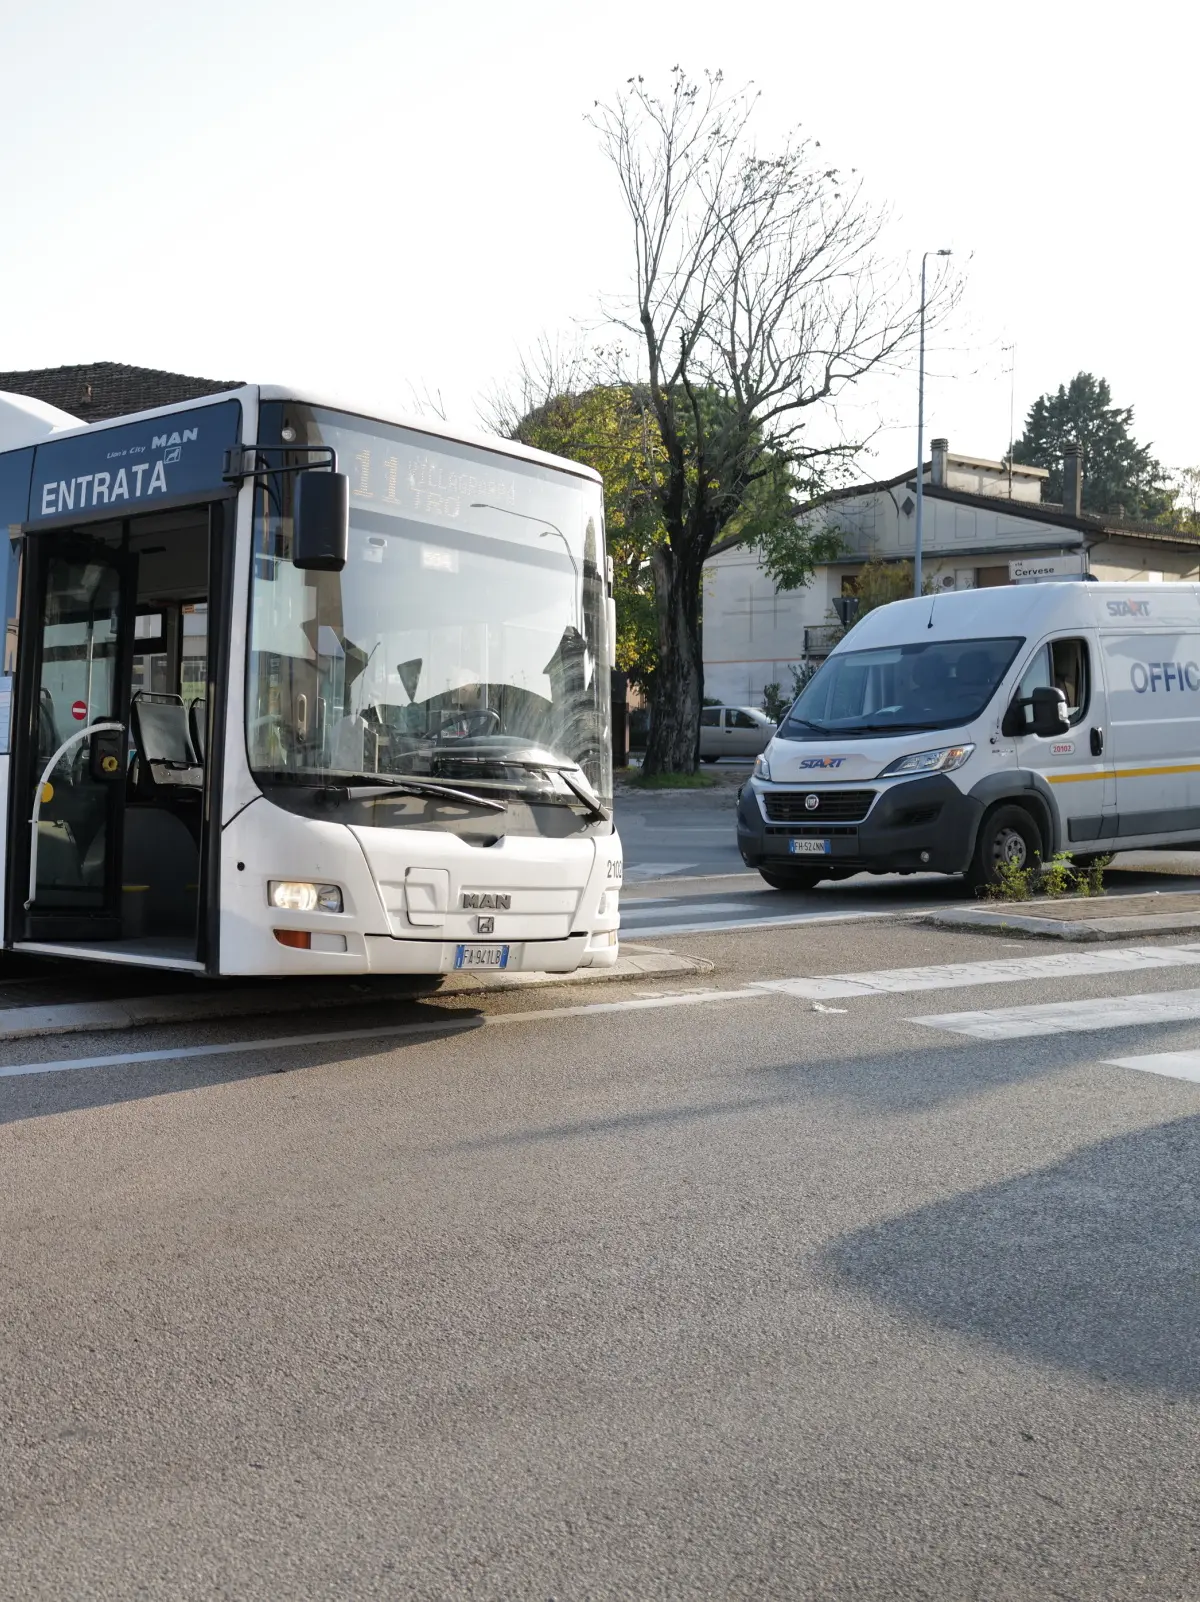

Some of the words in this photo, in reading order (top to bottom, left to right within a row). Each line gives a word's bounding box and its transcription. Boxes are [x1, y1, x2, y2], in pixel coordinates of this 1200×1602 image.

[151, 427, 199, 449] MAN
[107, 449, 128, 459] Lion's
[129, 446, 146, 455] City
[352, 449, 400, 505] 11
[41, 460, 168, 515] ENTRATA
[1014, 567, 1055, 577] Cervese
[1106, 600, 1150, 617] START
[799, 758, 846, 769] START
[462, 893, 512, 910] MAN
